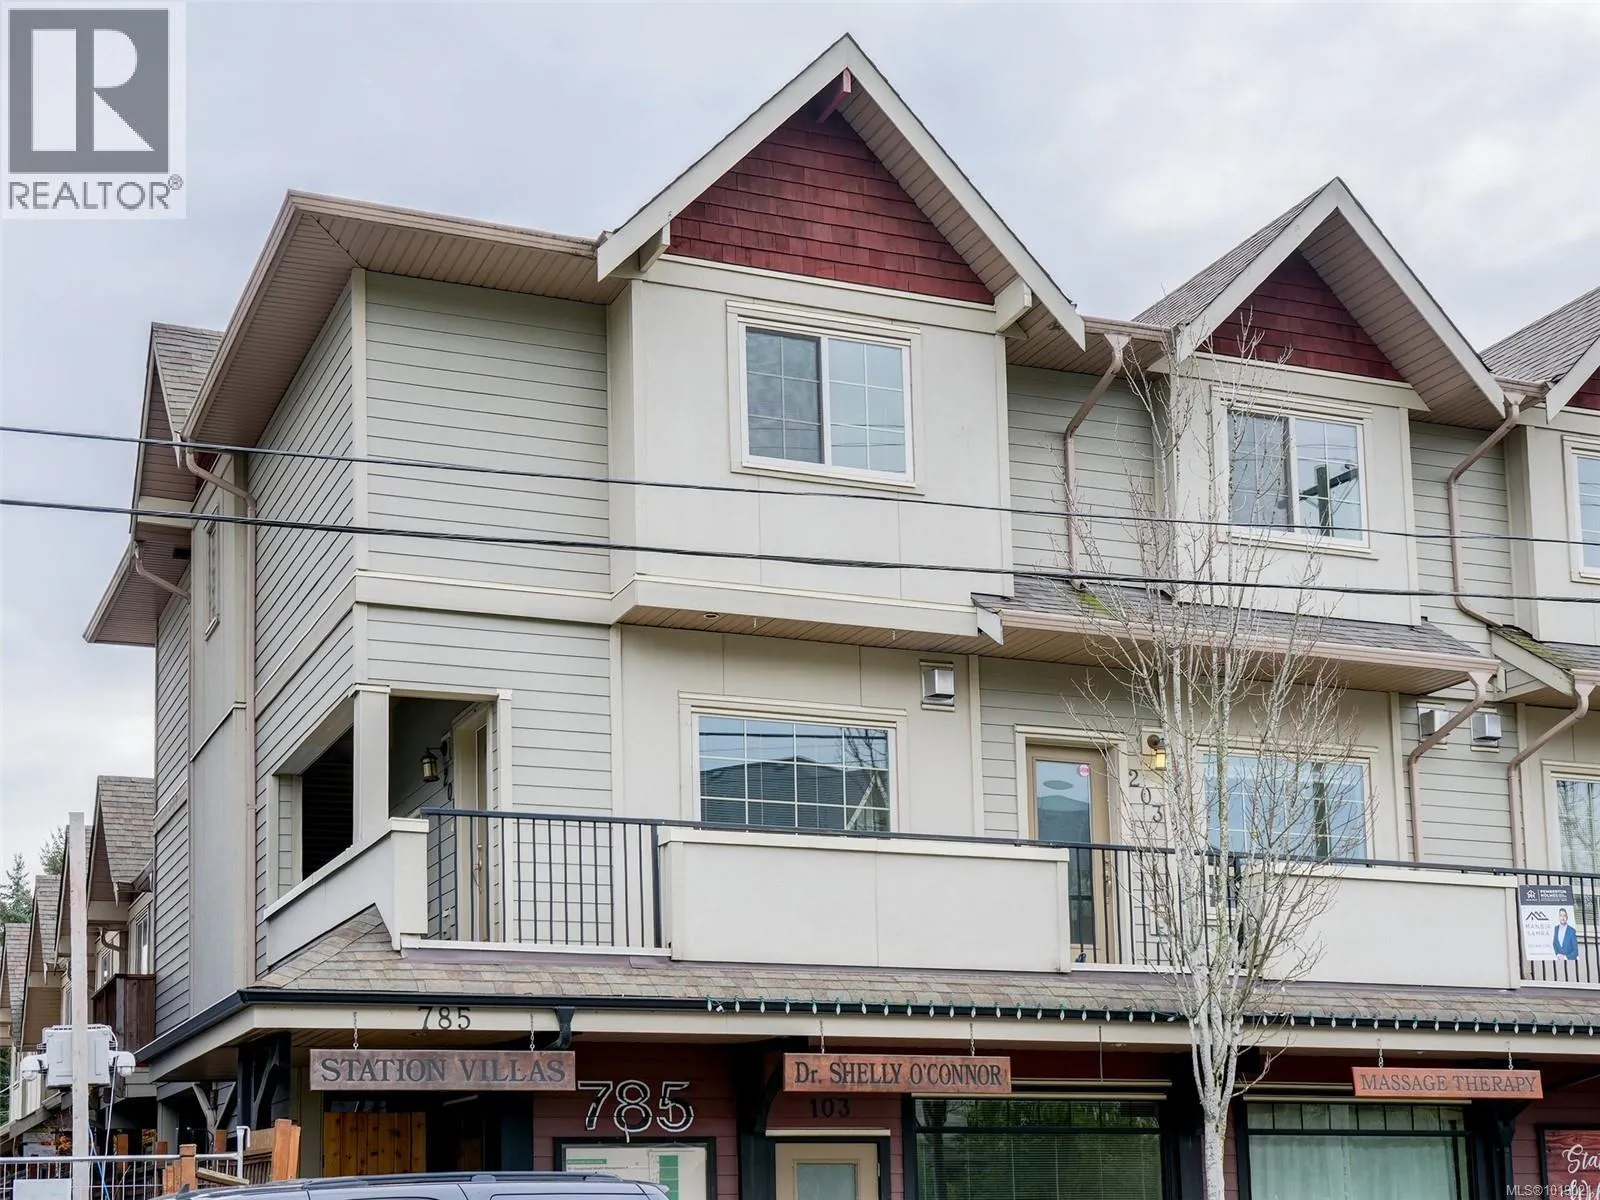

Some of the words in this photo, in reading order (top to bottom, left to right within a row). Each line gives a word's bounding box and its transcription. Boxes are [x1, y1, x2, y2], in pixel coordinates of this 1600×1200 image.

[1128, 769, 1163, 823] 203
[417, 1006, 471, 1030] 785
[320, 1057, 445, 1083] STATION
[459, 1058, 566, 1083] VILLAS
[794, 1061, 822, 1084] Dr.
[829, 1062, 903, 1085] SHELLY
[910, 1063, 1002, 1086] O'CONNOR
[1360, 1073, 1449, 1092] MASSAGE
[1452, 1074, 1537, 1093] THERAPY
[578, 1080, 694, 1133] 785
[811, 1098, 850, 1119] 103
[1562, 1144, 1600, 1174] Sta
